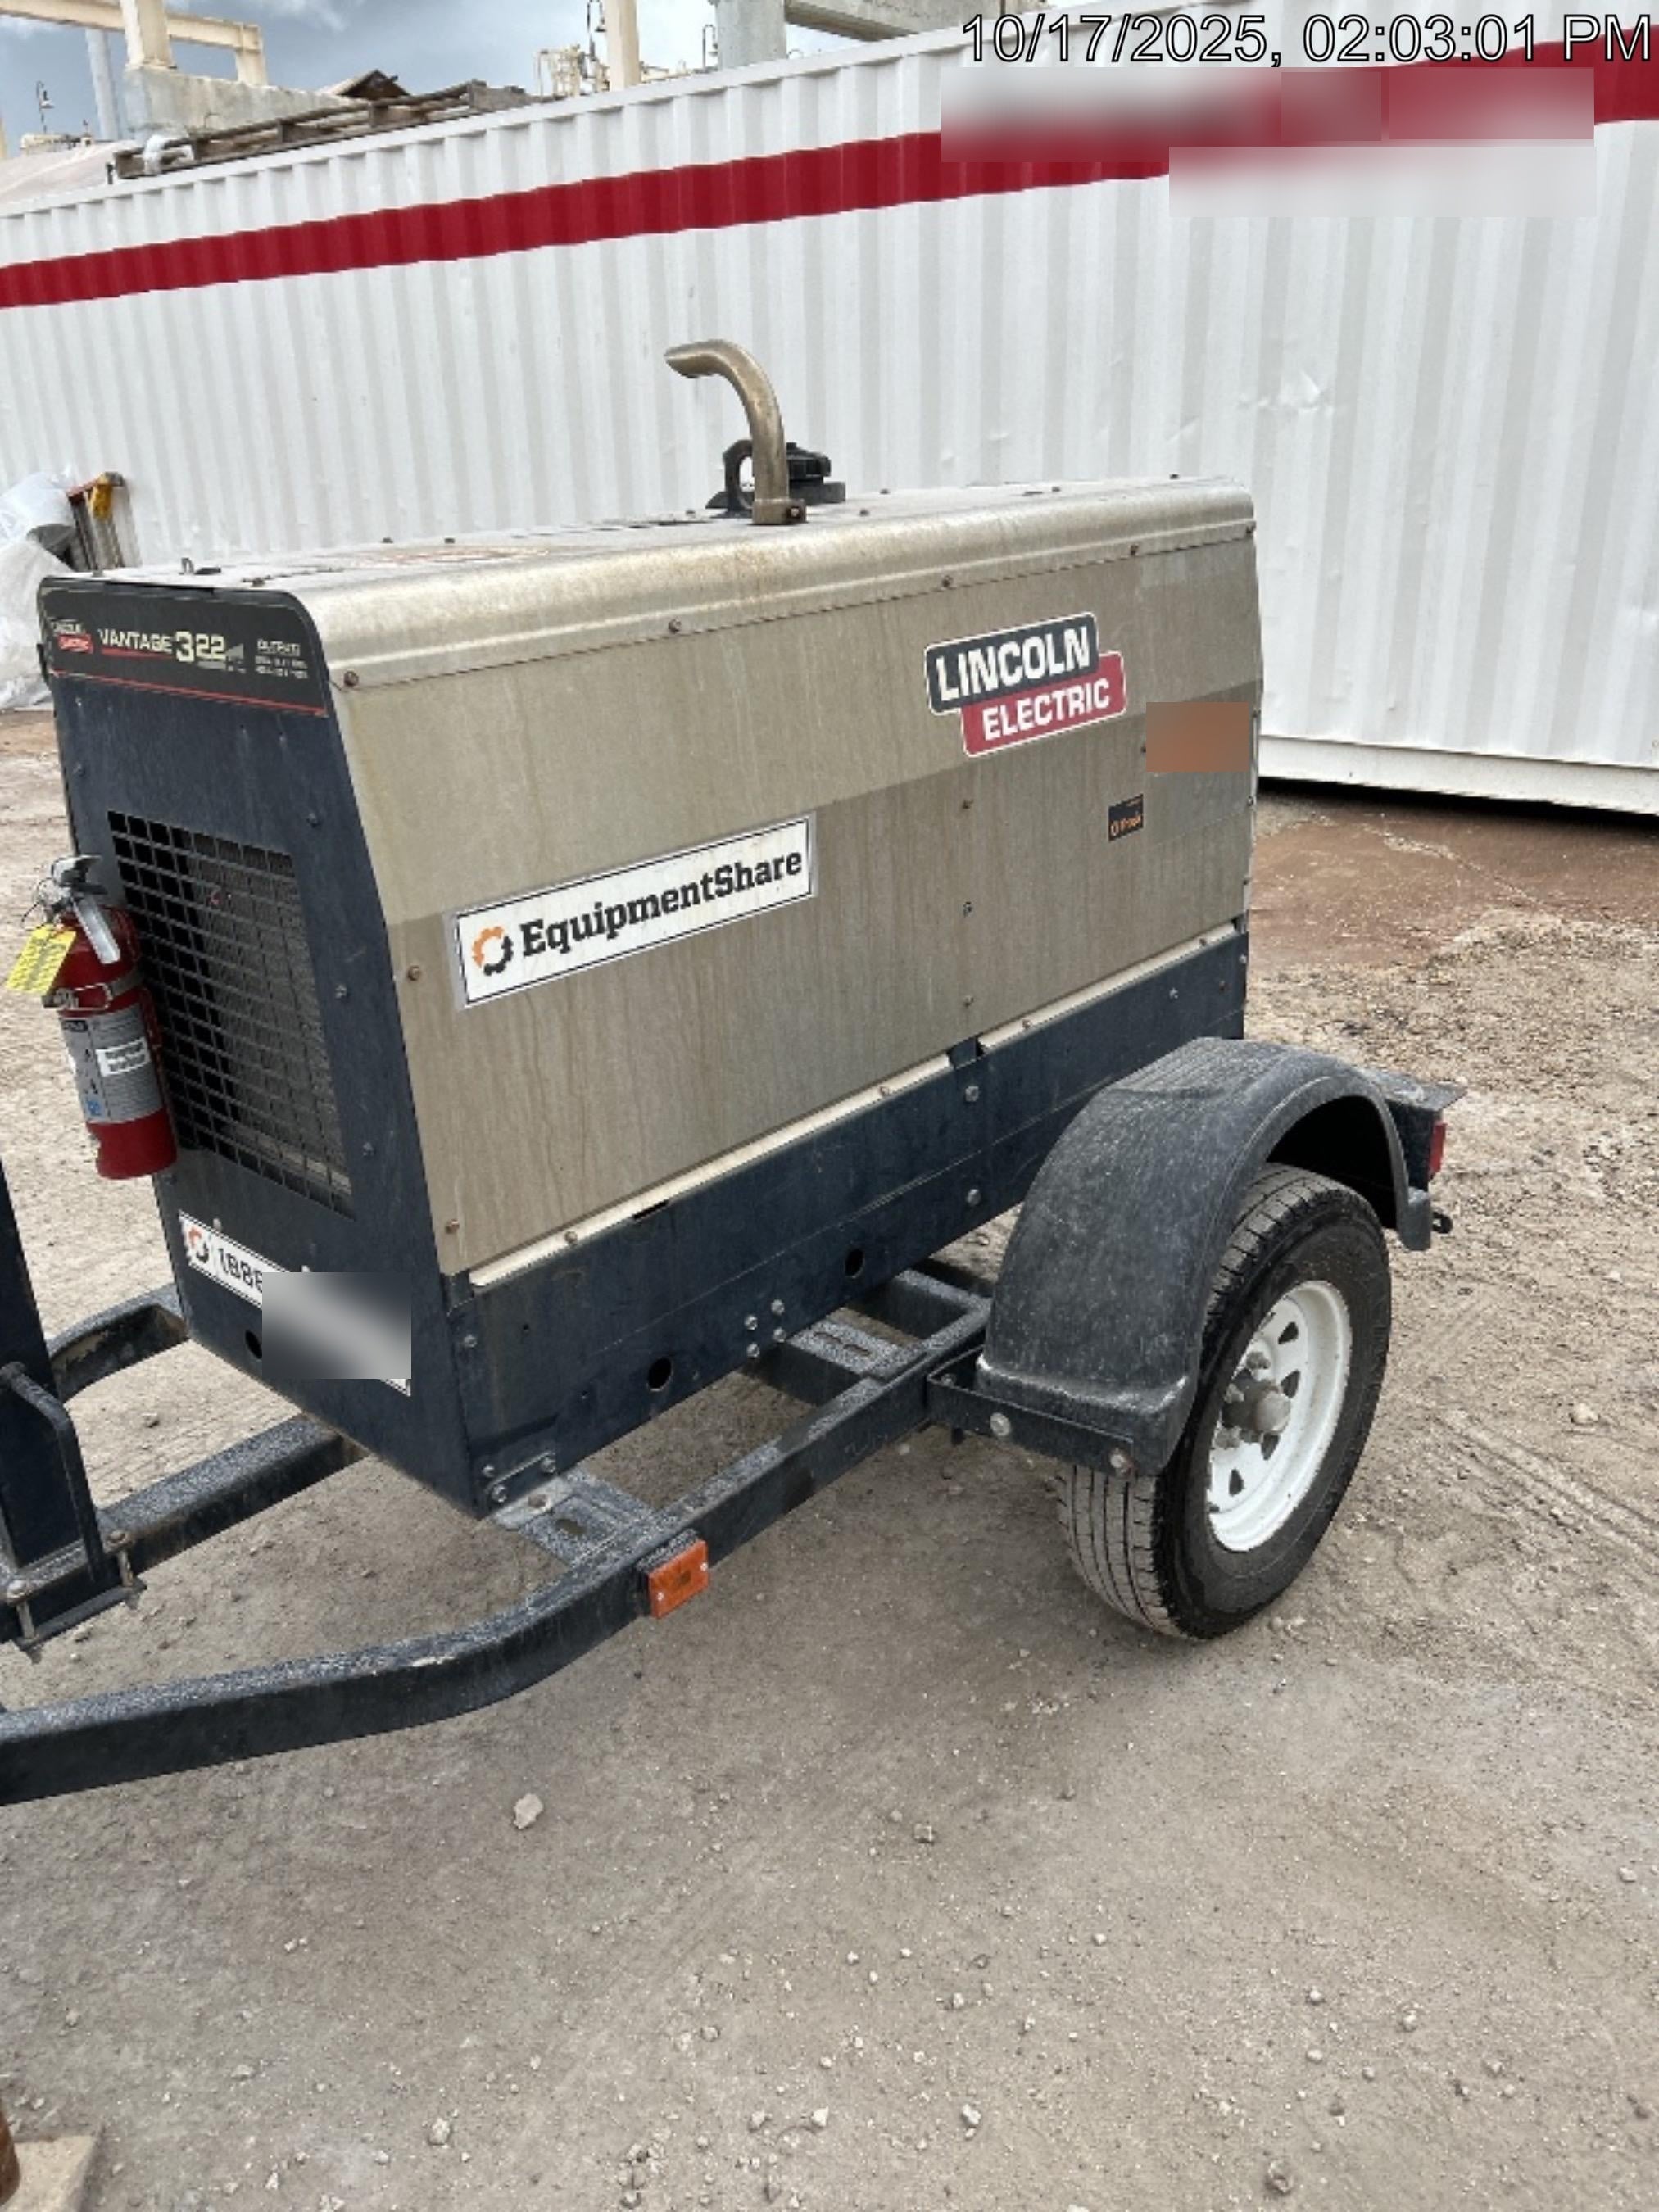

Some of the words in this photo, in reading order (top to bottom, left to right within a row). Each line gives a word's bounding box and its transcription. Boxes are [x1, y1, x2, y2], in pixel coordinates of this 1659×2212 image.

[98, 629, 173, 655] VANTAGE
[173, 630, 226, 663] 322
[936, 625, 1090, 702] LINCOLN
[982, 678, 1110, 741] ELECTRIC
[519, 850, 803, 958] EquipmentShare
